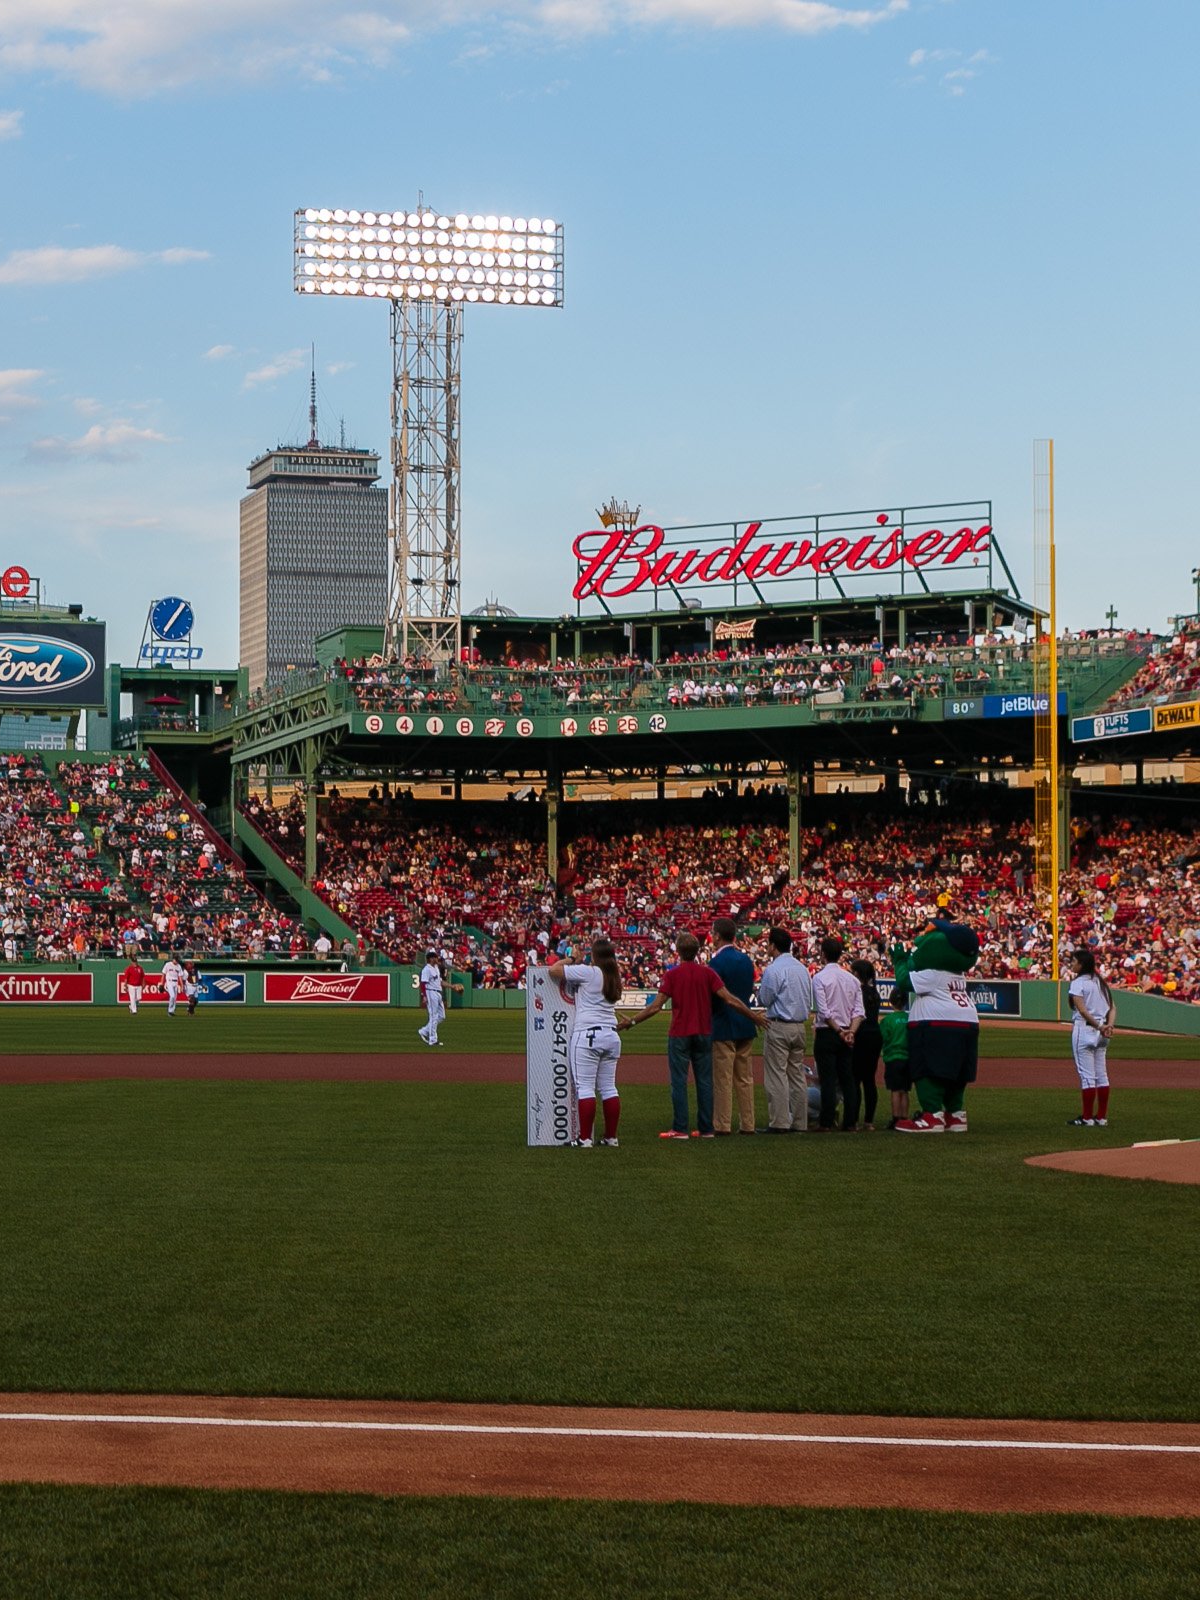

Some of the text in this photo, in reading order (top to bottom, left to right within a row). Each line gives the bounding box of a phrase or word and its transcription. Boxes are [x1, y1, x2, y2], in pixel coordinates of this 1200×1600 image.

[290, 456, 362, 466] PRUDENTIAL
[572, 513, 993, 600] Budweiser
[141, 642, 204, 664] tyco
[1000, 697, 1049, 715] jetBlue
[369, 718, 380, 731] 9
[399, 719, 409, 731] 4
[431, 719, 439, 732] 1
[460, 720, 470, 733] 8
[484, 720, 506, 734] 27
[588, 719, 608, 733] 45
[617, 718, 638, 732] 26
[649, 717, 666, 730] 42
[1105, 713, 1129, 727] TUFTS
[520, 721, 530, 734] 6
[560, 720, 576, 735] 14
[298, 979, 357, 994] Budweiser
[969, 991, 998, 1010] KAYEM
[551, 1010, 569, 1141] $547,000,000
